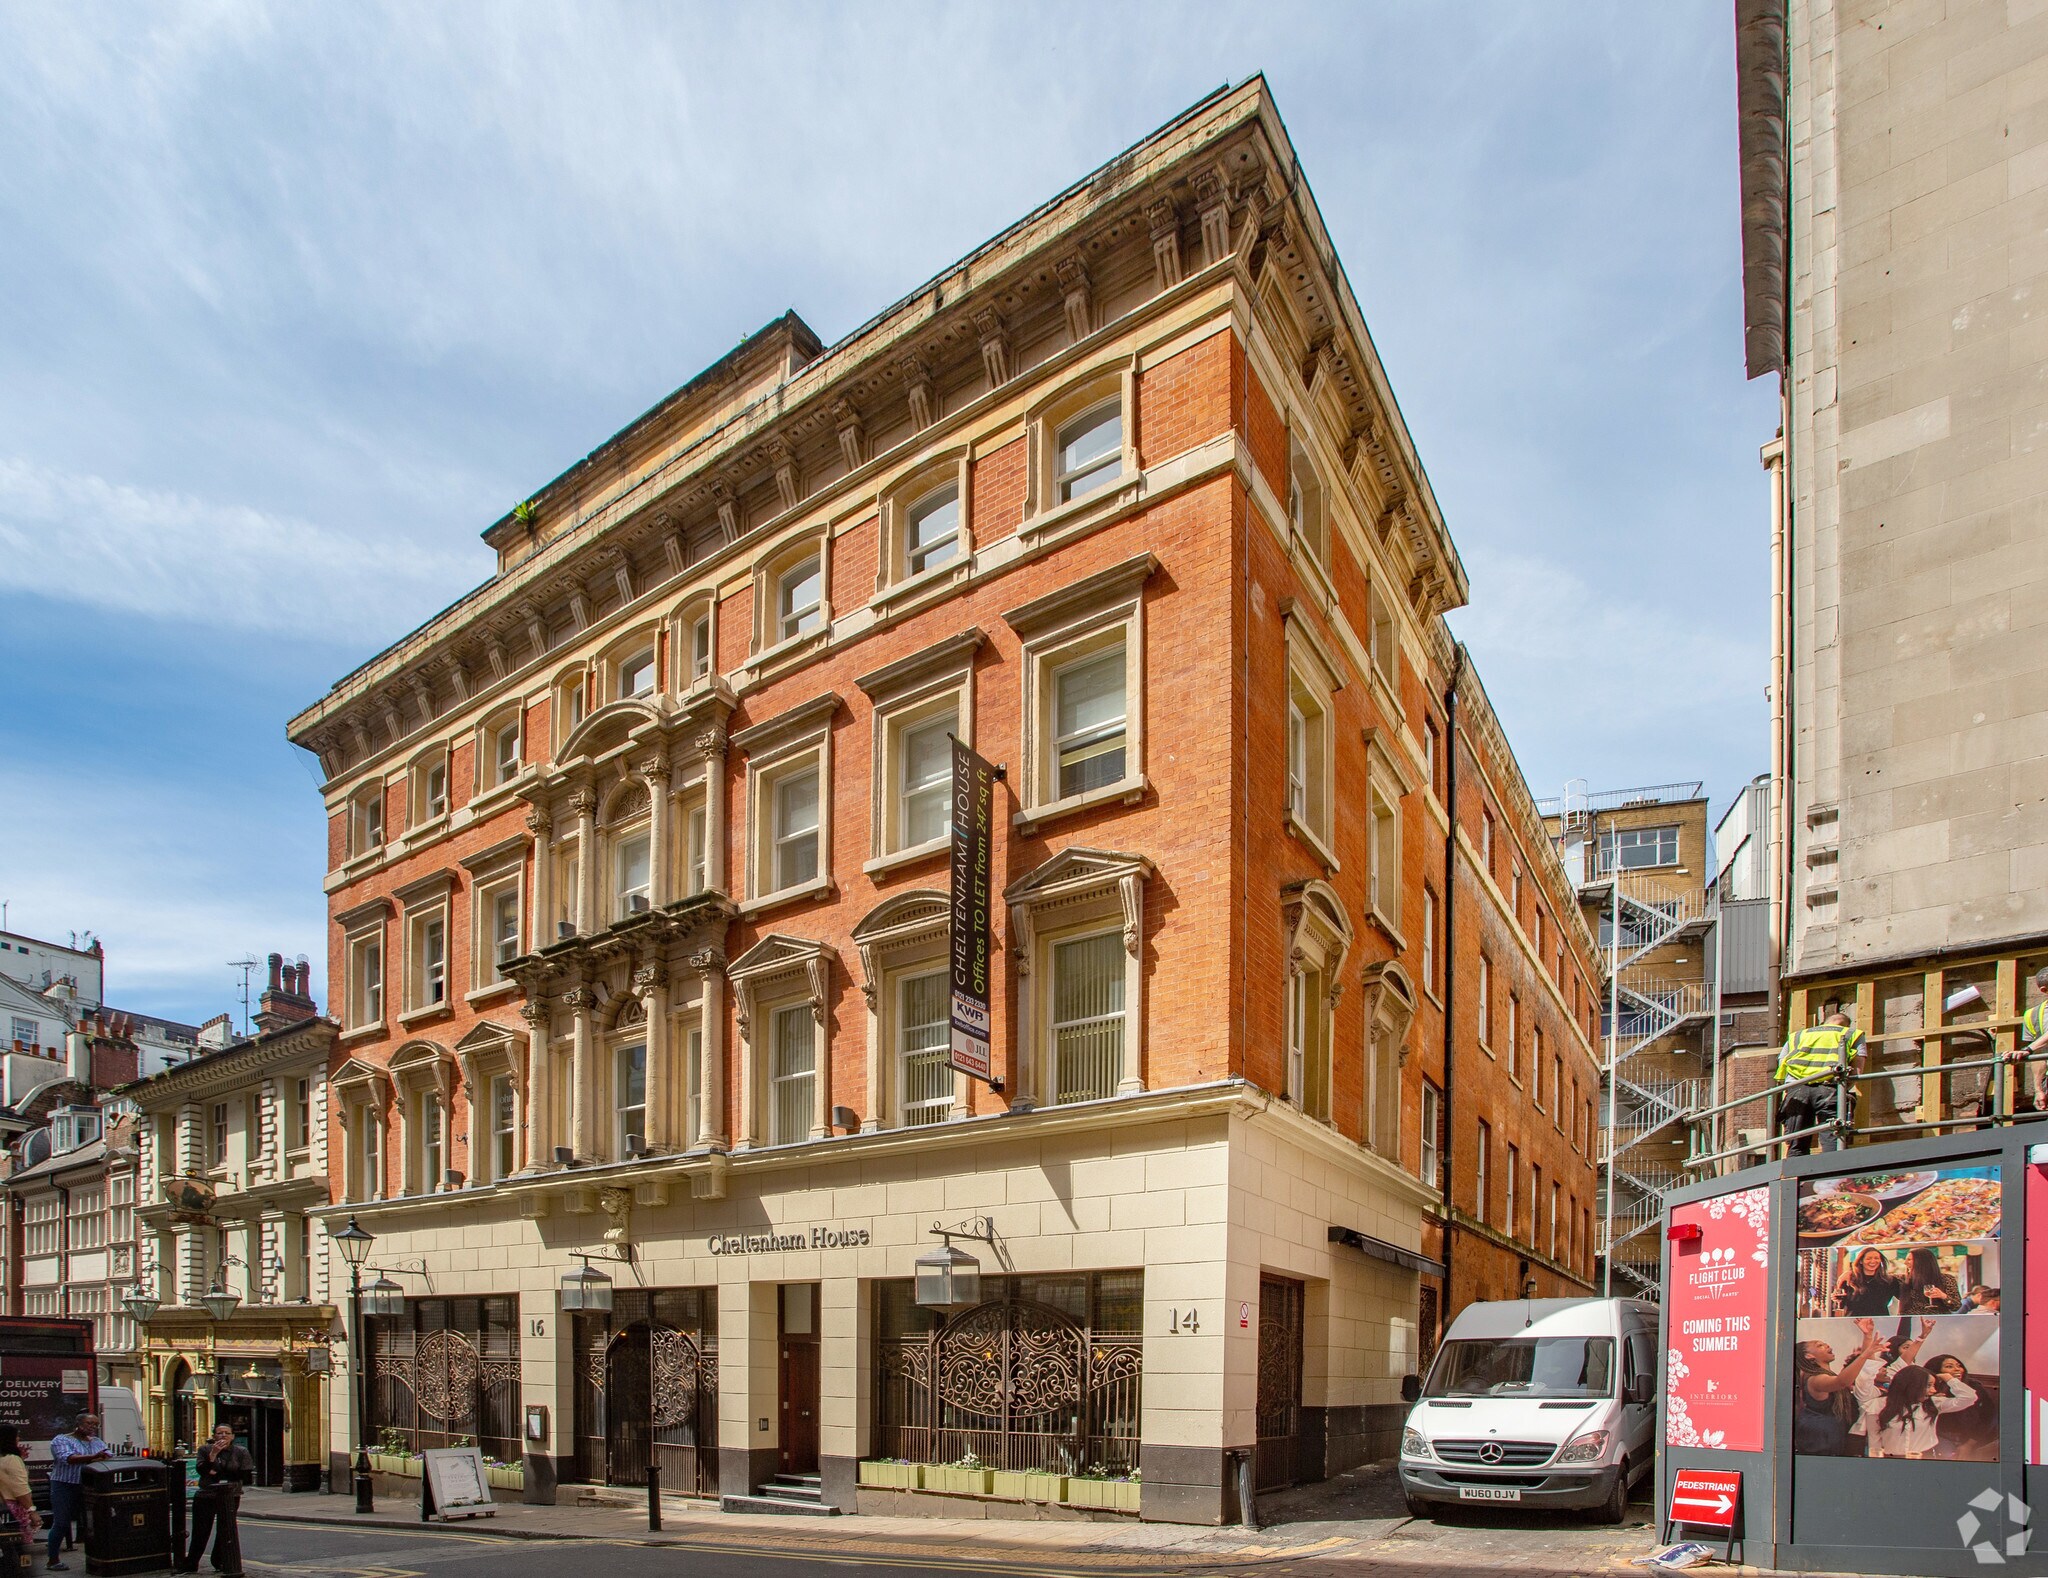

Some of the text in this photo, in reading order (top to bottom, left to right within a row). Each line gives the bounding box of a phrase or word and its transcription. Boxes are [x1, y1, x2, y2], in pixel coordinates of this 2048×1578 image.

[976, 767, 988, 784] ft
[976, 837, 987, 875] from
[955, 752, 970, 985] CHELTENHAM HOUSE
[975, 876, 986, 906] LET
[974, 909, 985, 932] TO
[973, 938, 985, 993] Offices
[956, 1001, 984, 1022] KWB
[954, 1052, 965, 1062] 0121
[975, 1044, 987, 1057] JLL
[707, 1226, 870, 1256] Cheltenham House
[1689, 1267, 1745, 1285] FLIGHT CLUB
[530, 1319, 545, 1336] 16
[1168, 1307, 1200, 1334] 14
[1683, 1315, 1751, 1335] COMING THIS
[1692, 1335, 1738, 1352] SUMMER
[5, 1380, 61, 1388] DELIVERY
[1464, 1489, 1515, 1499] WU60 OJV
[1677, 1480, 1736, 1492] PEDESTRIANS
